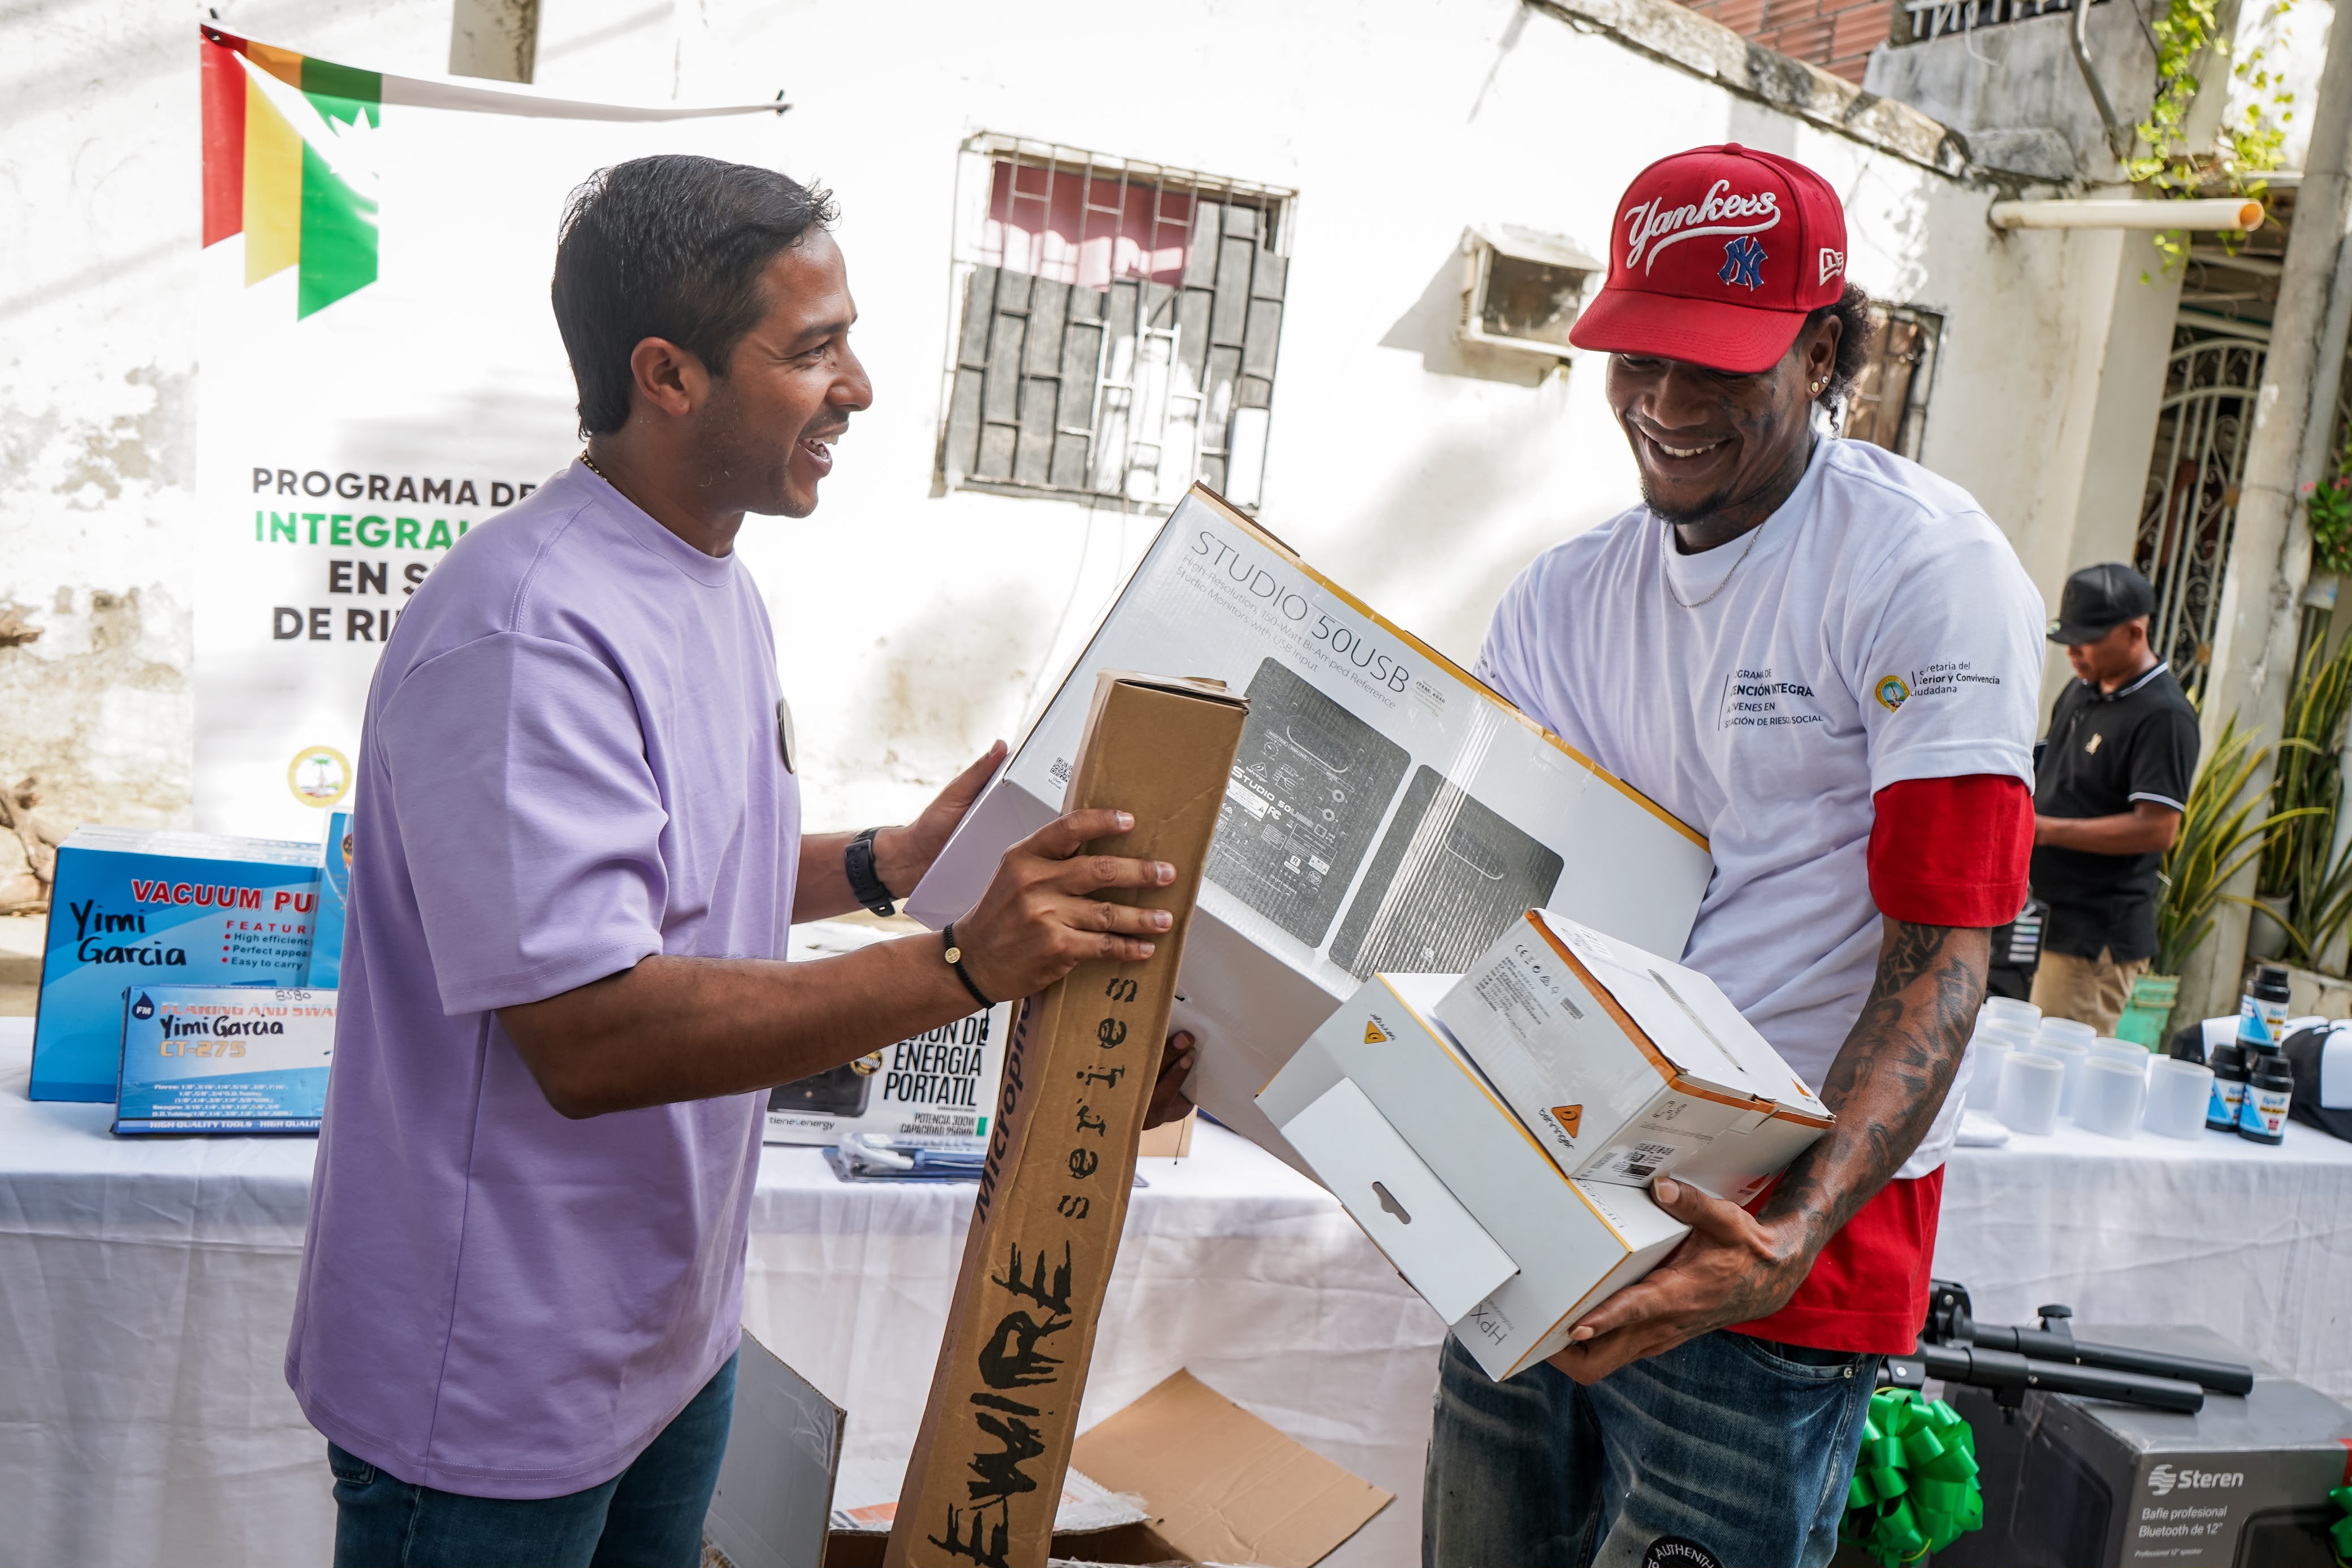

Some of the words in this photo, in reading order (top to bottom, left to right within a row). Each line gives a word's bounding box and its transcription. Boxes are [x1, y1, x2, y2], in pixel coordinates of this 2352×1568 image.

[1624, 179, 1778, 270] Yankees
[1717, 236, 1769, 292] NY
[253, 468, 479, 506] PROGRAMA
[329, 560, 387, 595] EN
[1176, 567, 1207, 591] Studio
[1207, 590, 1250, 622] Monitors
[1250, 620, 1272, 638] with
[1272, 636, 1292, 652] USB
[1291, 650, 1318, 672] Input
[1191, 531, 1308, 622] STUDIO
[1310, 615, 1410, 694] 50USB
[273, 607, 331, 640] DE
[346, 609, 399, 642] RI
[1182, 556, 1261, 613] High-Resolution,
[1260, 611, 1303, 643] 150-Watt
[1302, 641, 1350, 676] Bi-Amped
[1351, 670, 1396, 709] Reference
[1958, 661, 1971, 670] del
[1948, 675, 1953, 683] y
[1956, 673, 2000, 685] Convivencia
[1764, 702, 1775, 711] EN
[1792, 715, 1824, 724] SOCIAL
[1048, 778, 1063, 791] Manual
[1052, 776, 1062, 785] User
[1231, 765, 1275, 801] STUDIO
[131, 880, 263, 911] VACUUM
[274, 891, 319, 915] PU
[70, 899, 146, 942] Yimi
[226, 920, 315, 935] FEATUR
[232, 945, 271, 955] Perfect
[234, 933, 259, 943] High
[262, 934, 313, 945] efficienc
[77, 937, 187, 967] Garcia
[231, 956, 257, 967] Easy
[274, 961, 303, 970] carry
[136, 1006, 152, 1015] FM
[292, 1003, 338, 1017] SWA
[159, 1015, 209, 1039] Yimi
[213, 1013, 284, 1037] Garcia
[159, 1041, 246, 1057] CT-275
[884, 1072, 977, 1106] PORTATIL
[1057, 977, 1138, 1220] series
[915, 1112, 951, 1125] POTENCIA
[1538, 1107, 1575, 1149] behringer
[1469, 1304, 1507, 1346] HPX
[2177, 1470, 2244, 1489] Steren
[2141, 1508, 2169, 1521] Bafle
[2170, 1506, 2228, 1522] profesional
[2139, 1523, 2189, 1538] Bluetooth
[2191, 1524, 2203, 1535] de
